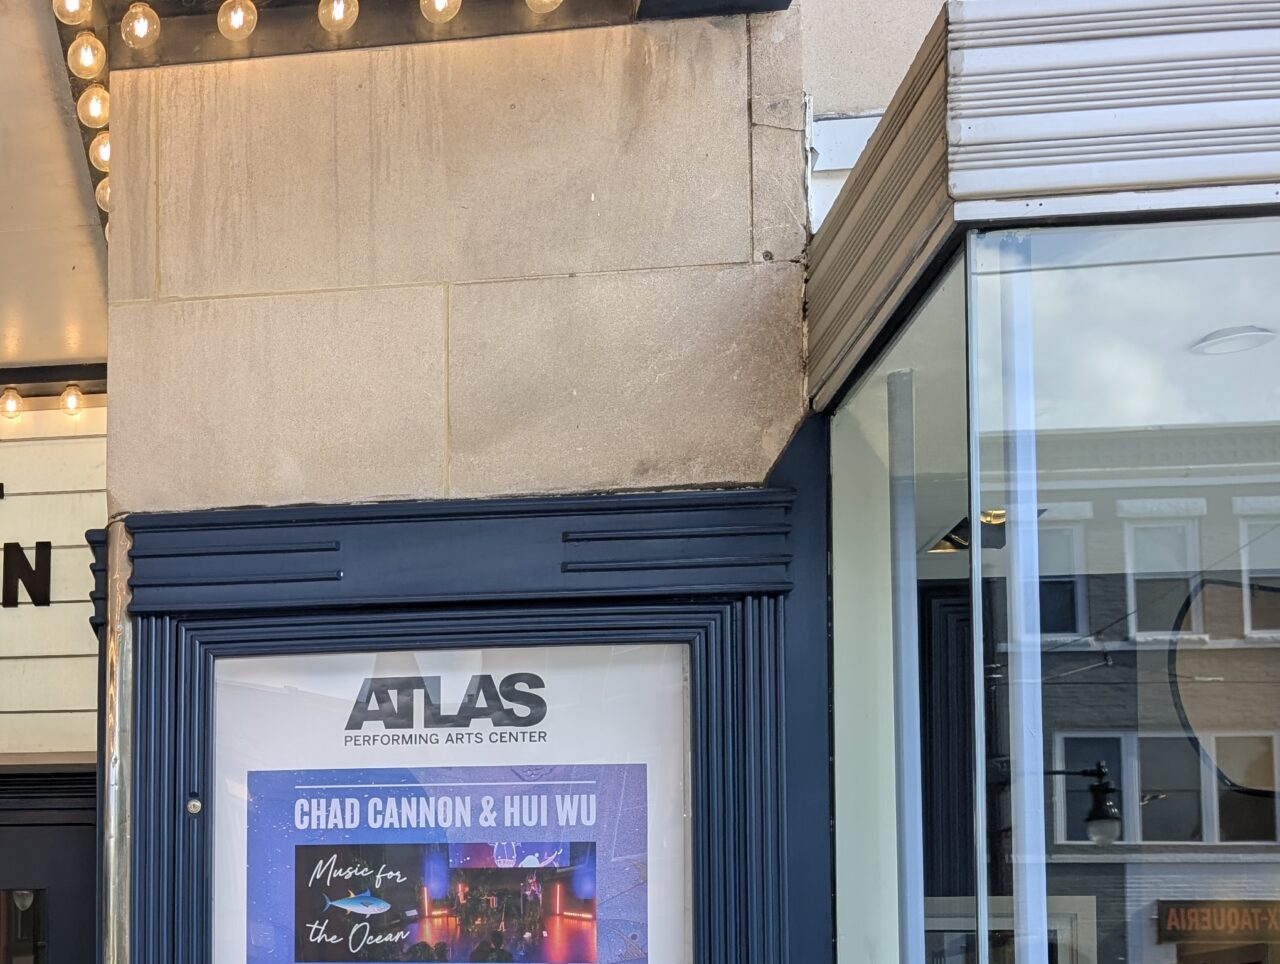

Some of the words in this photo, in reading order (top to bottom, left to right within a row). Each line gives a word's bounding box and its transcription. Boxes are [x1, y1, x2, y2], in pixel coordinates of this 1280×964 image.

[344, 672, 548, 731] ATLAS
[344, 733, 440, 747] PERFORMING
[445, 732, 484, 744] ARTS
[488, 731, 548, 744] CENTER
[294, 798, 360, 829] CHAD
[367, 796, 471, 829] CANNON
[479, 795, 498, 827] &
[504, 795, 548, 827] HUI
[555, 794, 597, 827] WU
[308, 853, 374, 888] Music
[375, 864, 407, 888] for
[306, 919, 343, 944] the
[348, 922, 410, 954] Ocean
